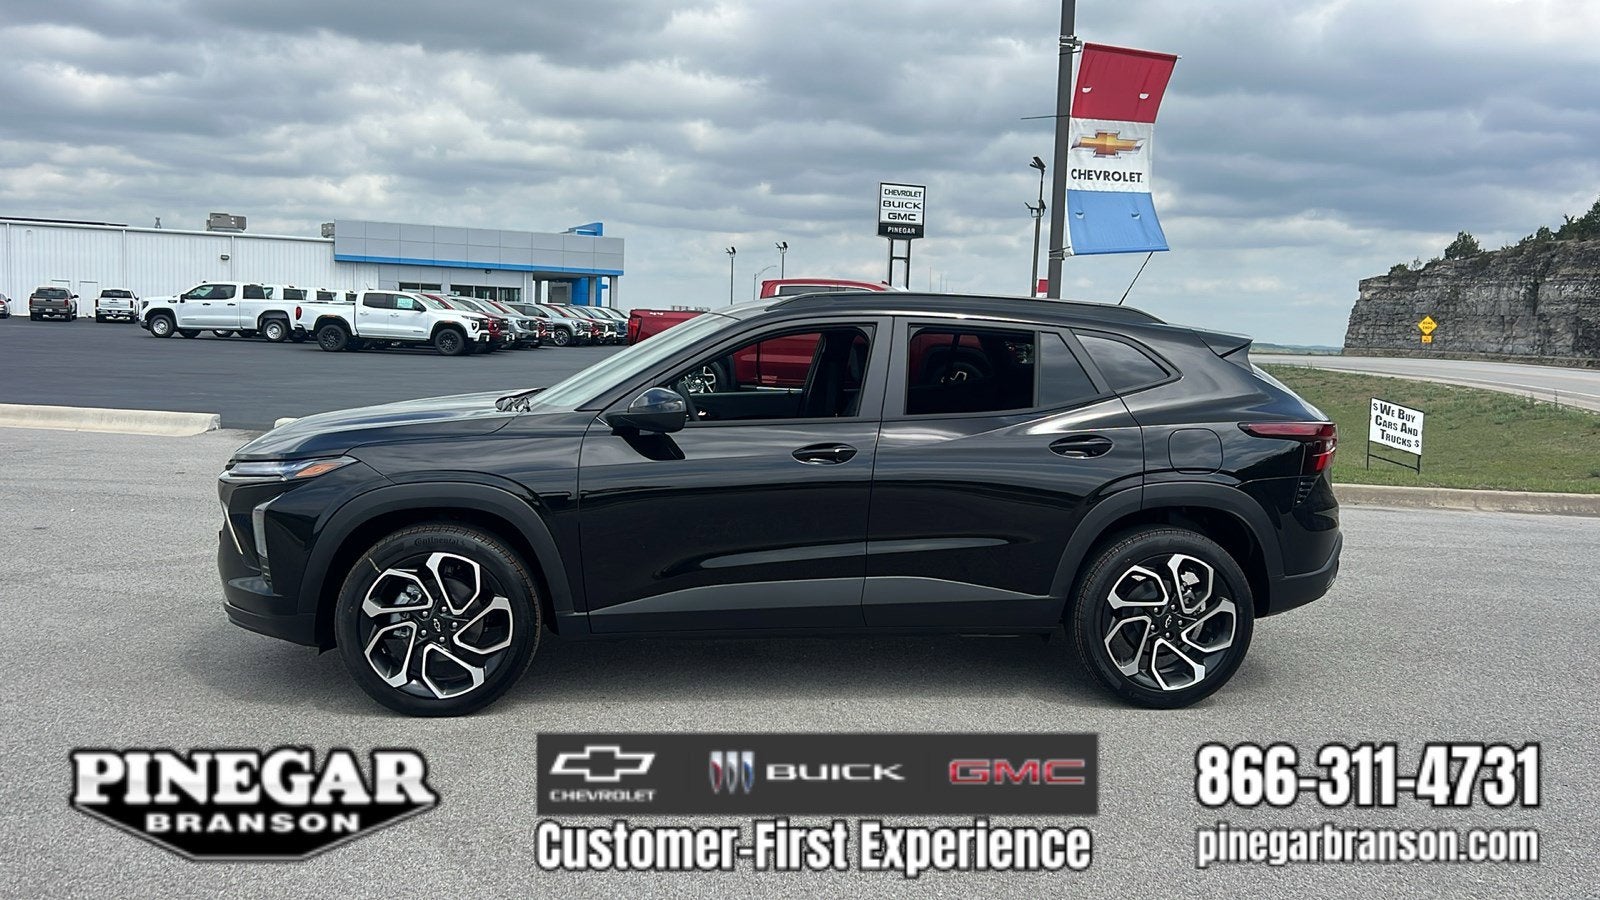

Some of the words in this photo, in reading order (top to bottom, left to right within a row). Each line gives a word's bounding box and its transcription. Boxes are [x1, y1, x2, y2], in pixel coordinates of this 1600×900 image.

[1071, 168, 1142, 183] CHEVROLET
[884, 188, 922, 198] CHEVROLET
[883, 200, 921, 210] BUICK
[888, 212, 916, 221] GMC
[887, 226, 916, 234] PINEGAR
[415, 537, 459, 547] Continental
